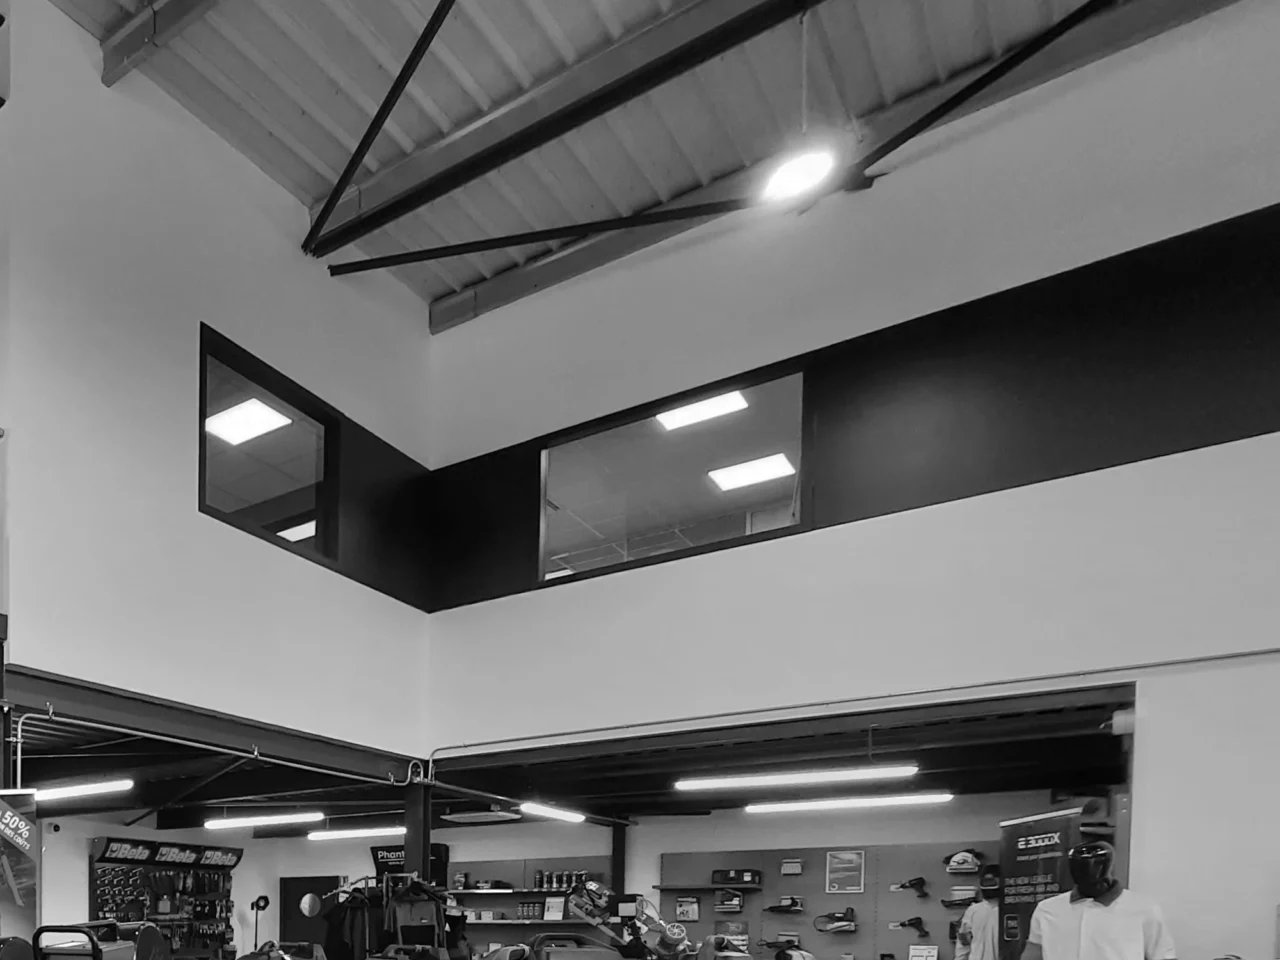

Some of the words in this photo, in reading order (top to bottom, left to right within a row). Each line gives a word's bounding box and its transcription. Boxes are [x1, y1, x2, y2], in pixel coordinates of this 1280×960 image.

[1, 810, 31, 839] 50%
[119, 844, 150, 860] Beta
[169, 848, 197, 863] Beta
[210, 851, 238, 866] Beta
[377, 850, 405, 859] Phant
